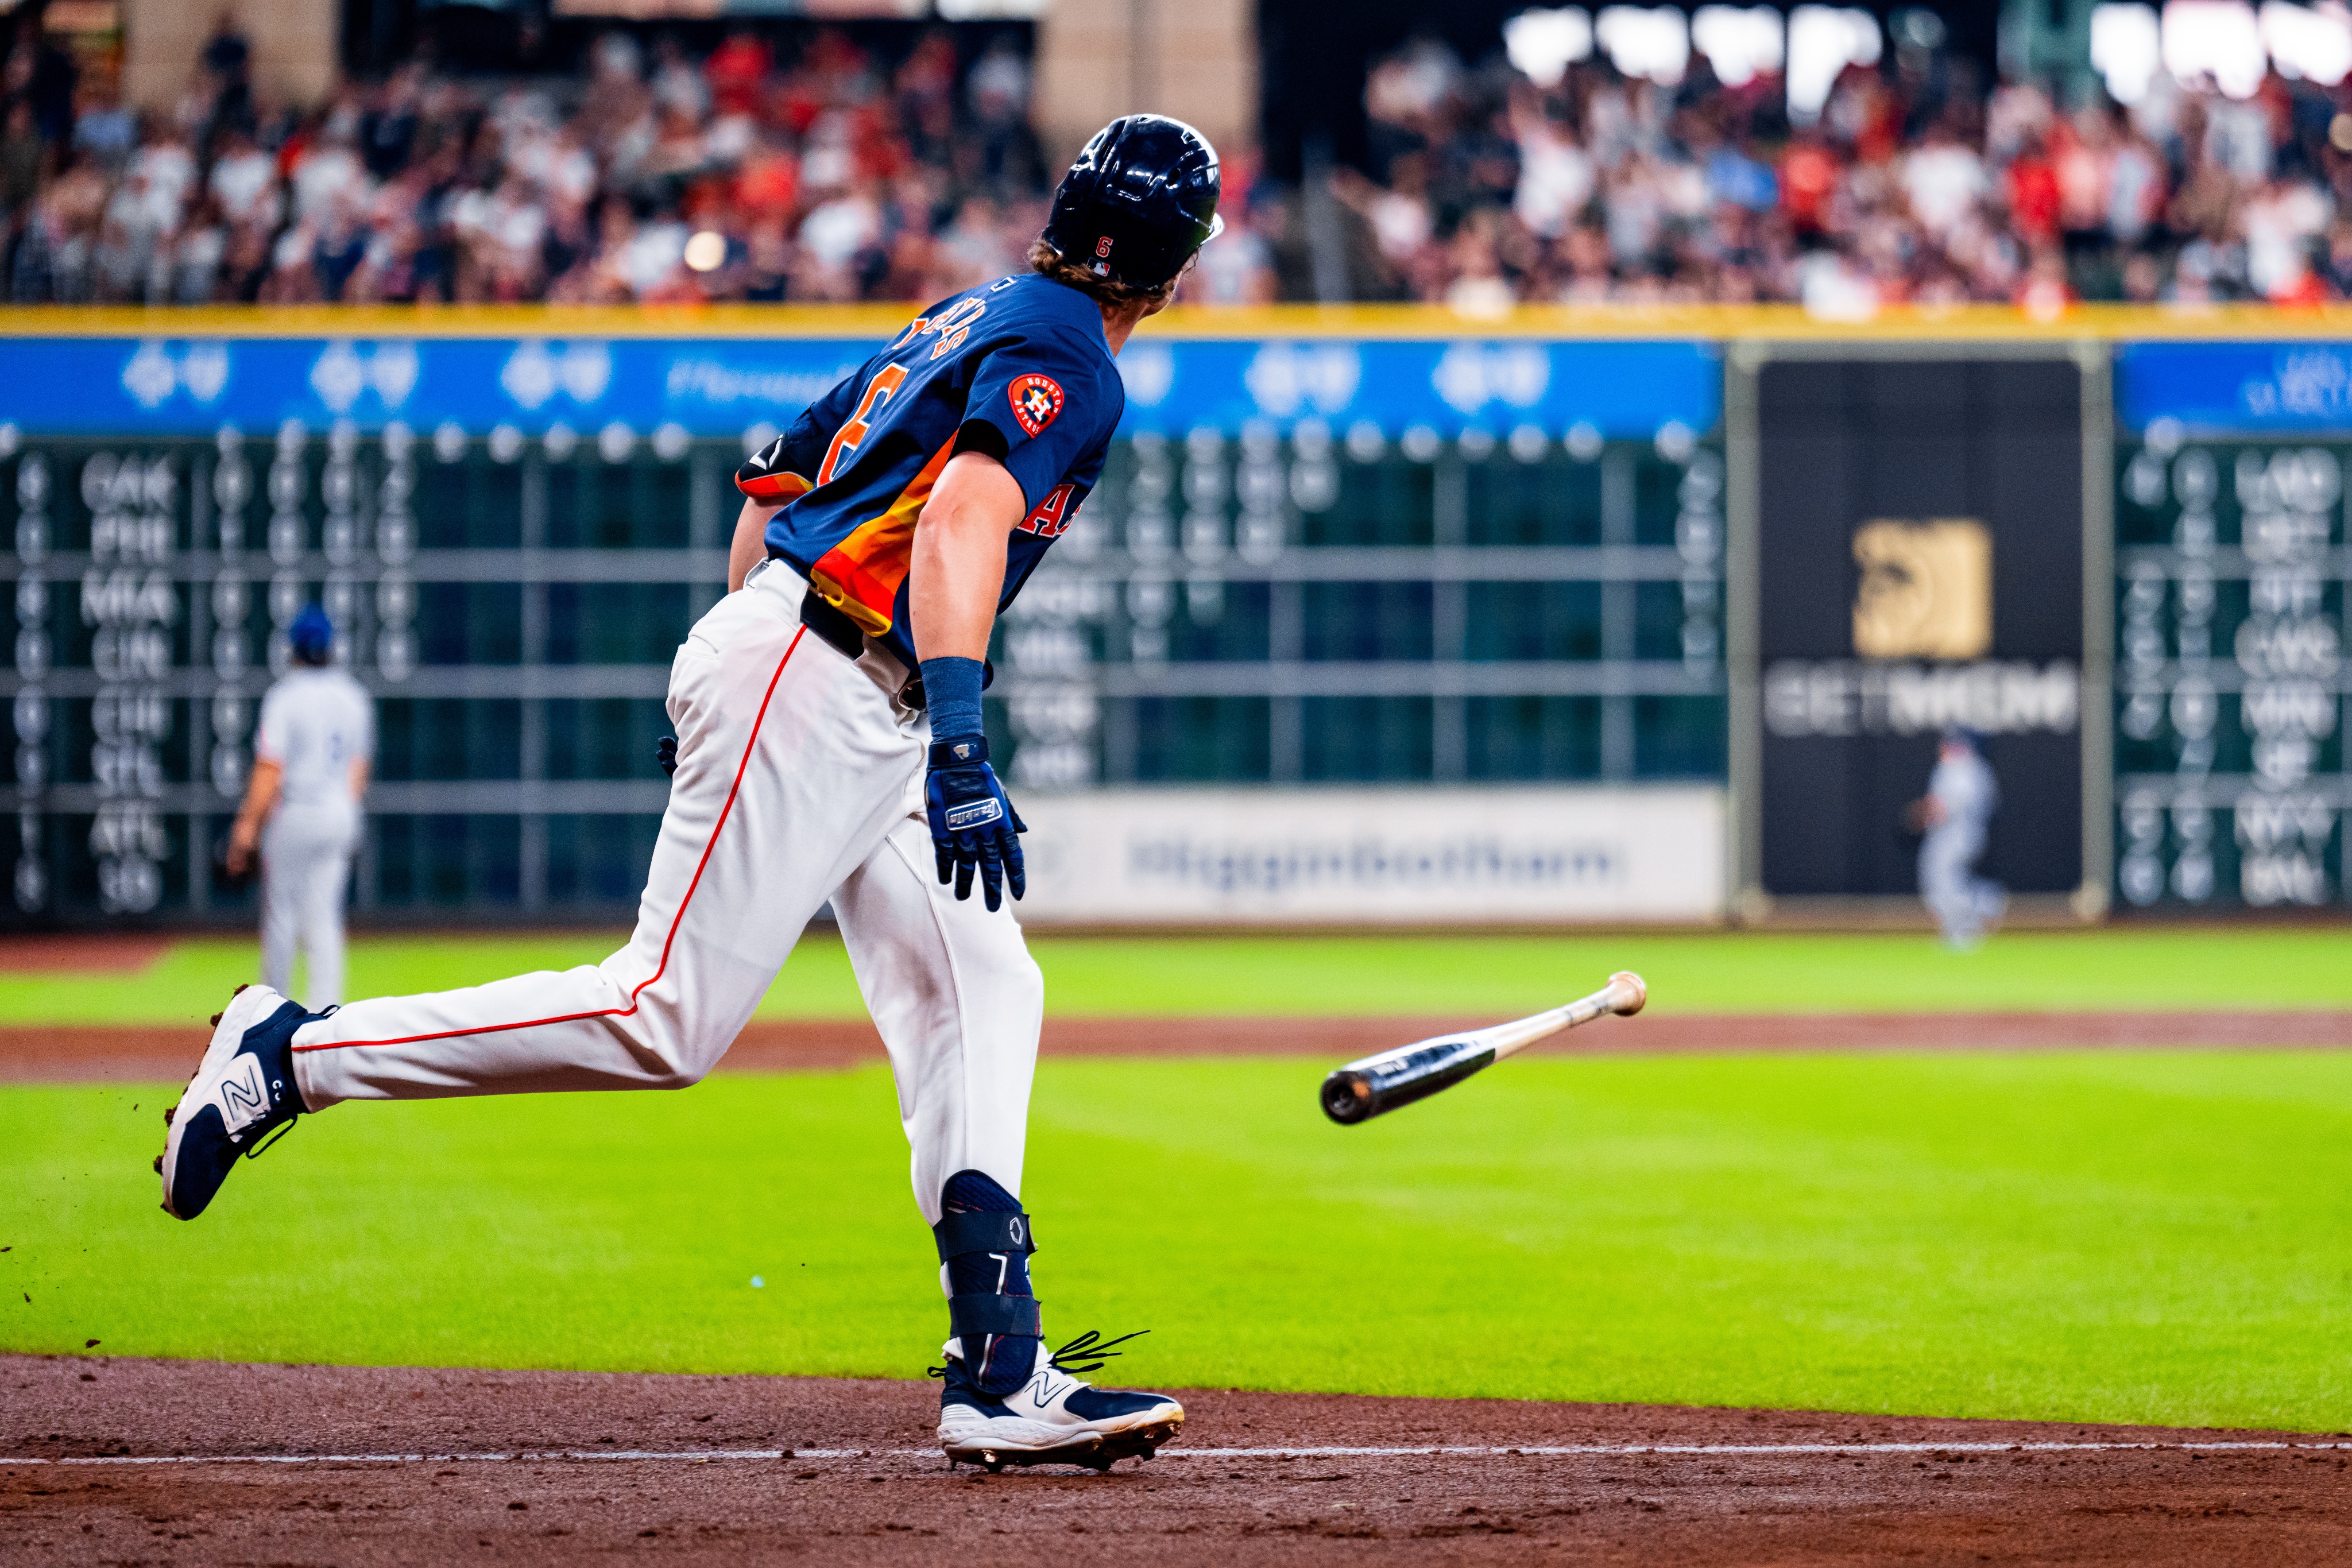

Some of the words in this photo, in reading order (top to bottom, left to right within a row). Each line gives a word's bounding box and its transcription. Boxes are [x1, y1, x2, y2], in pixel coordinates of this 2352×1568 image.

[1096, 236, 1113, 258] 6
[1027, 378, 1061, 413] HOUSTON
[1014, 400, 1040, 434] ASTROS
